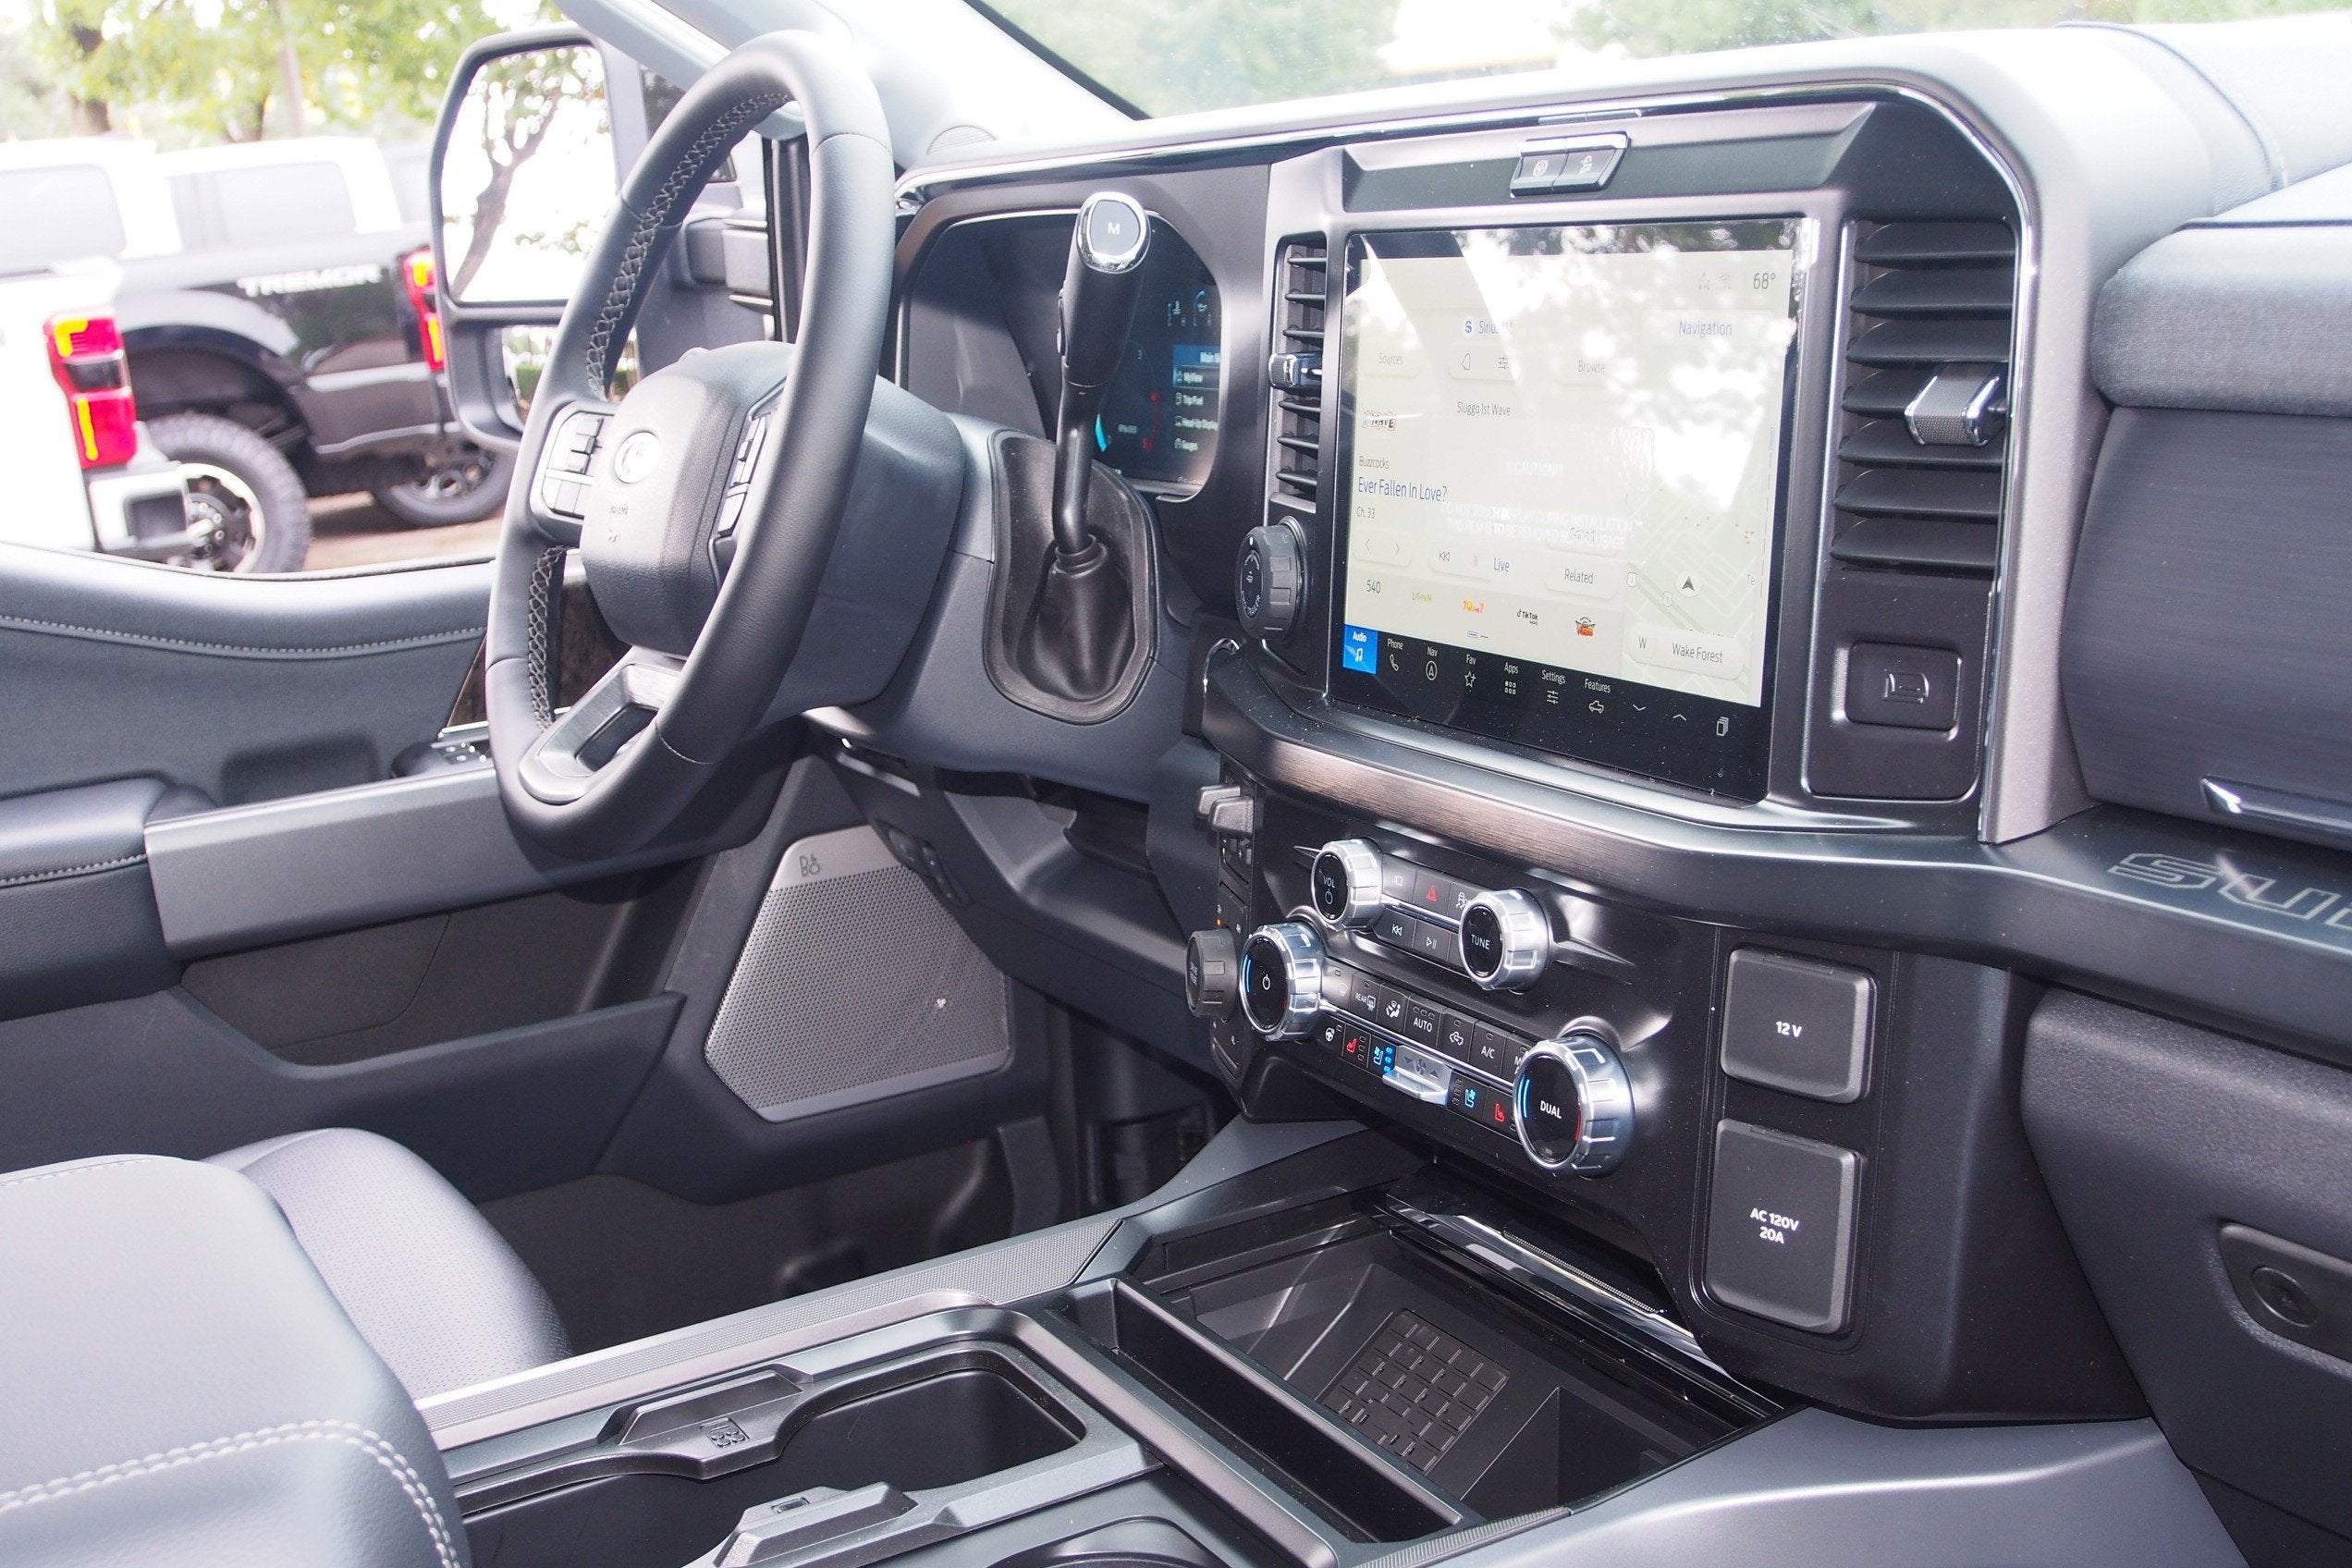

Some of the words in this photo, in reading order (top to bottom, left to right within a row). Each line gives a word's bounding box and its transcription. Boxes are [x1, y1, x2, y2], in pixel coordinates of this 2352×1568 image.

[1108, 222, 1121, 235] M
[237, 265, 382, 298] TREMOR
[1678, 319, 1733, 338] Navigation
[1378, 352, 1404, 366] Sources
[1577, 359, 1606, 376] Browse
[1456, 401, 1479, 417] Sluggo
[1491, 405, 1512, 418] Wave
[1359, 455, 1390, 471] Buzzcocks
[1358, 477, 1378, 495] Ever
[1378, 479, 1407, 498] Fallen
[1419, 484, 1448, 503] Love?
[1493, 557, 1510, 573] Live
[1564, 569, 1594, 584] Related
[1366, 579, 1381, 594] 540
[1353, 631, 1367, 643] Audio
[1387, 638, 1403, 651] Phone
[1638, 636, 1648, 649] W
[1427, 646, 1438, 658] Nav
[1465, 654, 1476, 666] Fav
[1672, 642, 1696, 658] Wake
[1697, 646, 1723, 664] Forest
[1504, 662, 1519, 675] Apps
[1541, 669, 1566, 685] Settings
[1584, 678, 1611, 693] Features
[1323, 875, 1336, 888] VOL
[1470, 934, 1490, 950] TUNE
[1413, 1017, 1433, 1033] AUTO
[1775, 1021, 1790, 1036] 12
[1792, 1024, 1803, 1038] V
[1480, 1045, 1496, 1060] A/C
[1539, 1100, 1562, 1120] DUAL
[1749, 1207, 1768, 1223] AC
[1769, 1212, 1800, 1232] 120V
[1758, 1226, 1785, 1244] 20A
